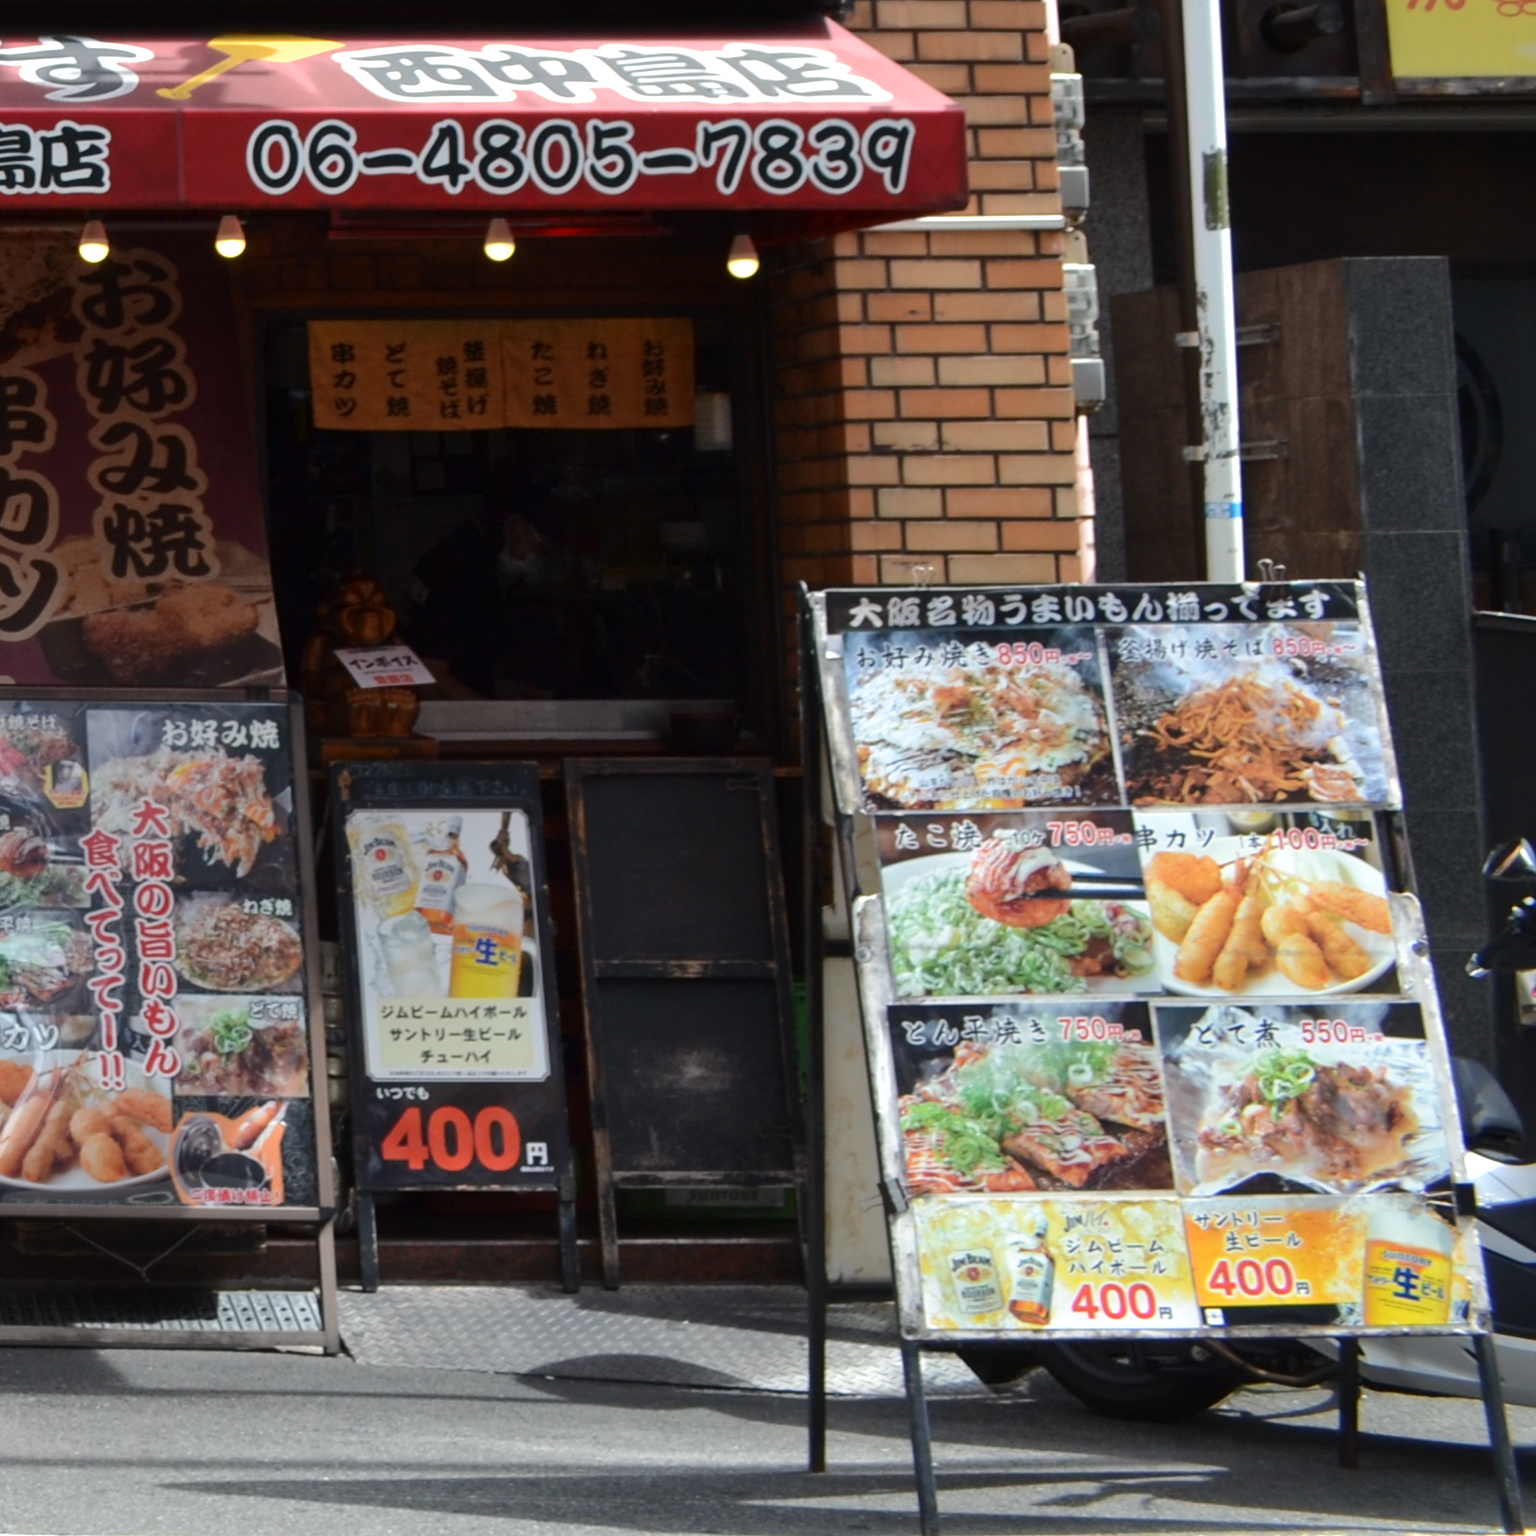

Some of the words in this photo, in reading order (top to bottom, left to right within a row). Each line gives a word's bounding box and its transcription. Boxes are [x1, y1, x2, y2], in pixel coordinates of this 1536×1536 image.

[336, 44, 894, 104] 西中島店
[246, 121, 912, 198] 06-4805-7839
[331, 342, 358, 419] 串カツ
[436, 355, 462, 420] 焼そば
[531, 340, 559, 417] たこ焼
[586, 340, 613, 417] ねぎ焼
[642, 339, 670, 418] お好み焼
[848, 588, 1331, 628] 大阪名物うまいもん揃ってます
[857, 641, 992, 671] お好み焼き
[161, 718, 282, 751] お好み焼
[895, 820, 982, 850] たこ焼
[1137, 827, 1217, 855] 串カツ
[242, 897, 295, 918] ねぎ焼
[131, 797, 184, 1080] 大阪の旨いもん
[381, 1004, 528, 1020] ジムビームハイボール
[390, 1027, 522, 1043] サントリー生ビール
[420, 1049, 492, 1064] チューハイ
[376, 1086, 431, 1101] いつでも
[1194, 1211, 1283, 1229] サントリー
[1066, 1238, 1165, 1255] ジムビーム
[1224, 1231, 1302, 1252] 生ビール
[1069, 1261, 1168, 1277] ハイボール
